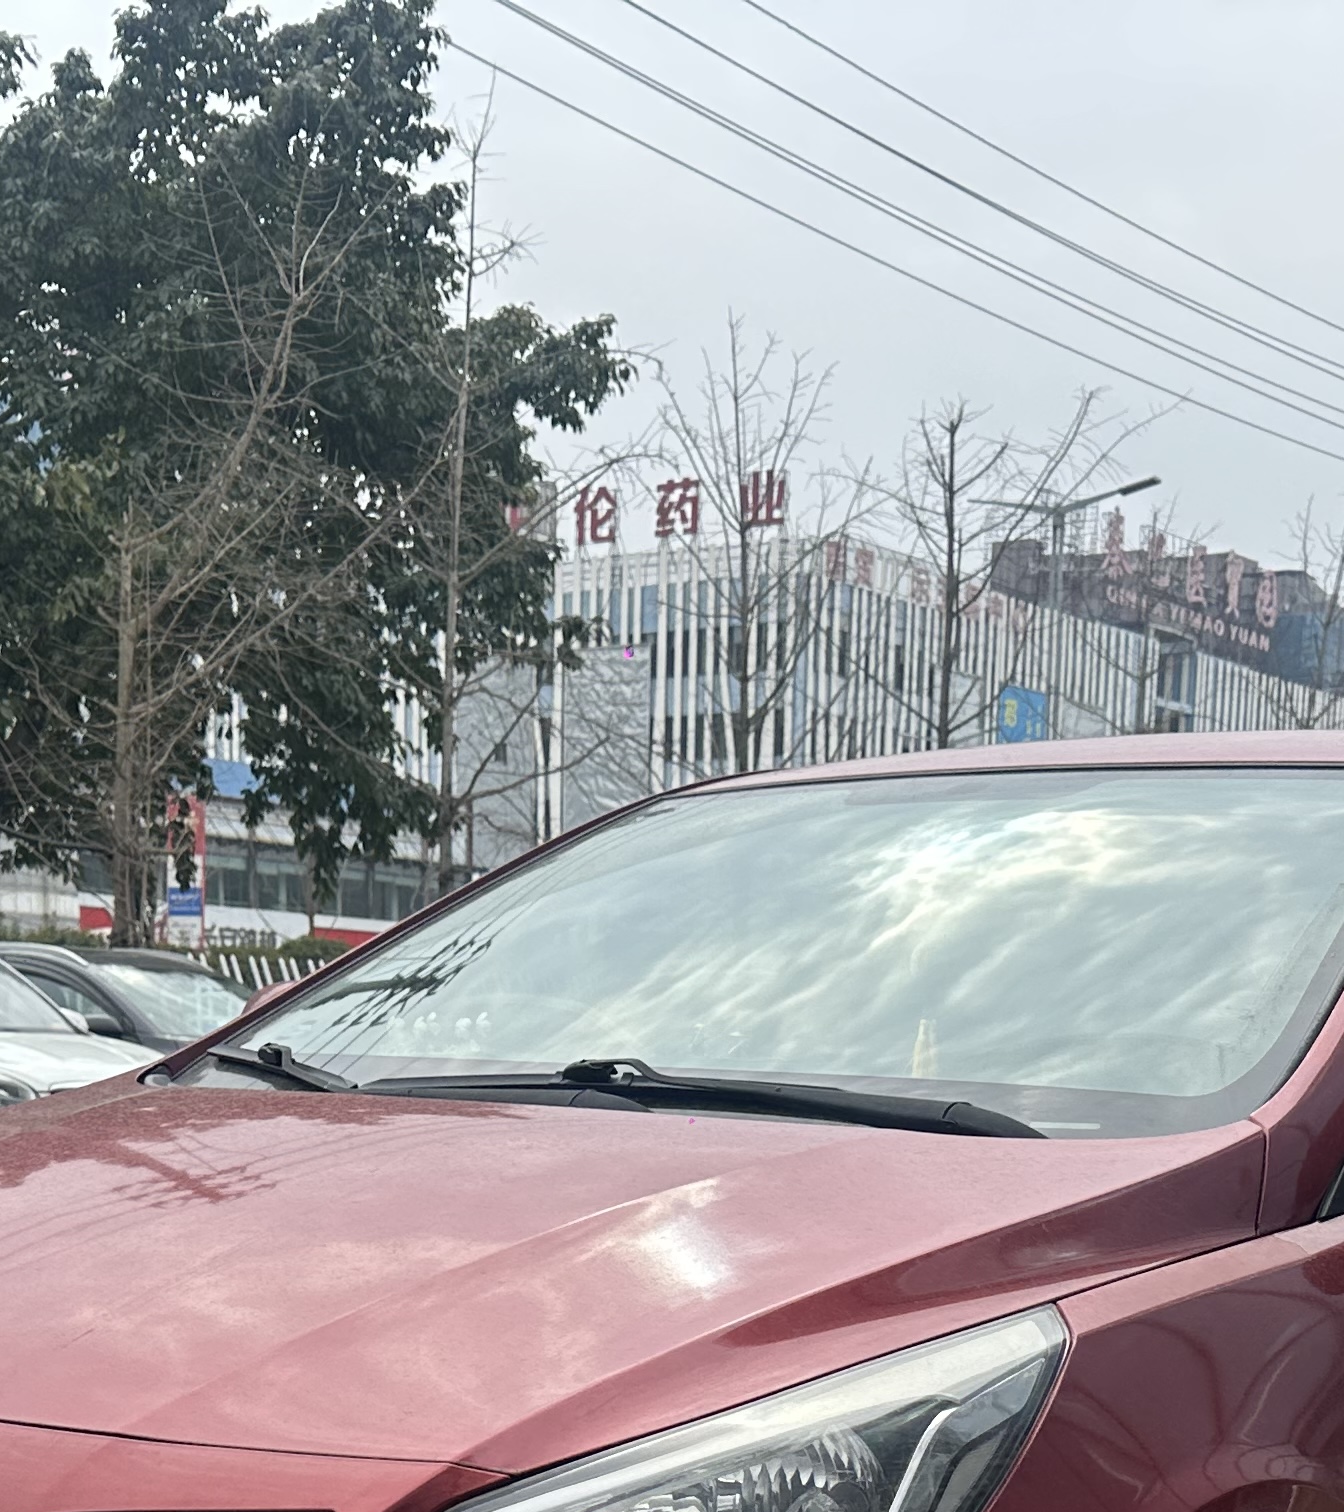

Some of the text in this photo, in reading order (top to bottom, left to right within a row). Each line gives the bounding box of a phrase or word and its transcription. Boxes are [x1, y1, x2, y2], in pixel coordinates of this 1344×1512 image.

[502, 470, 785, 545] 伦药业
[1230, 624, 1271, 653] YUAN
